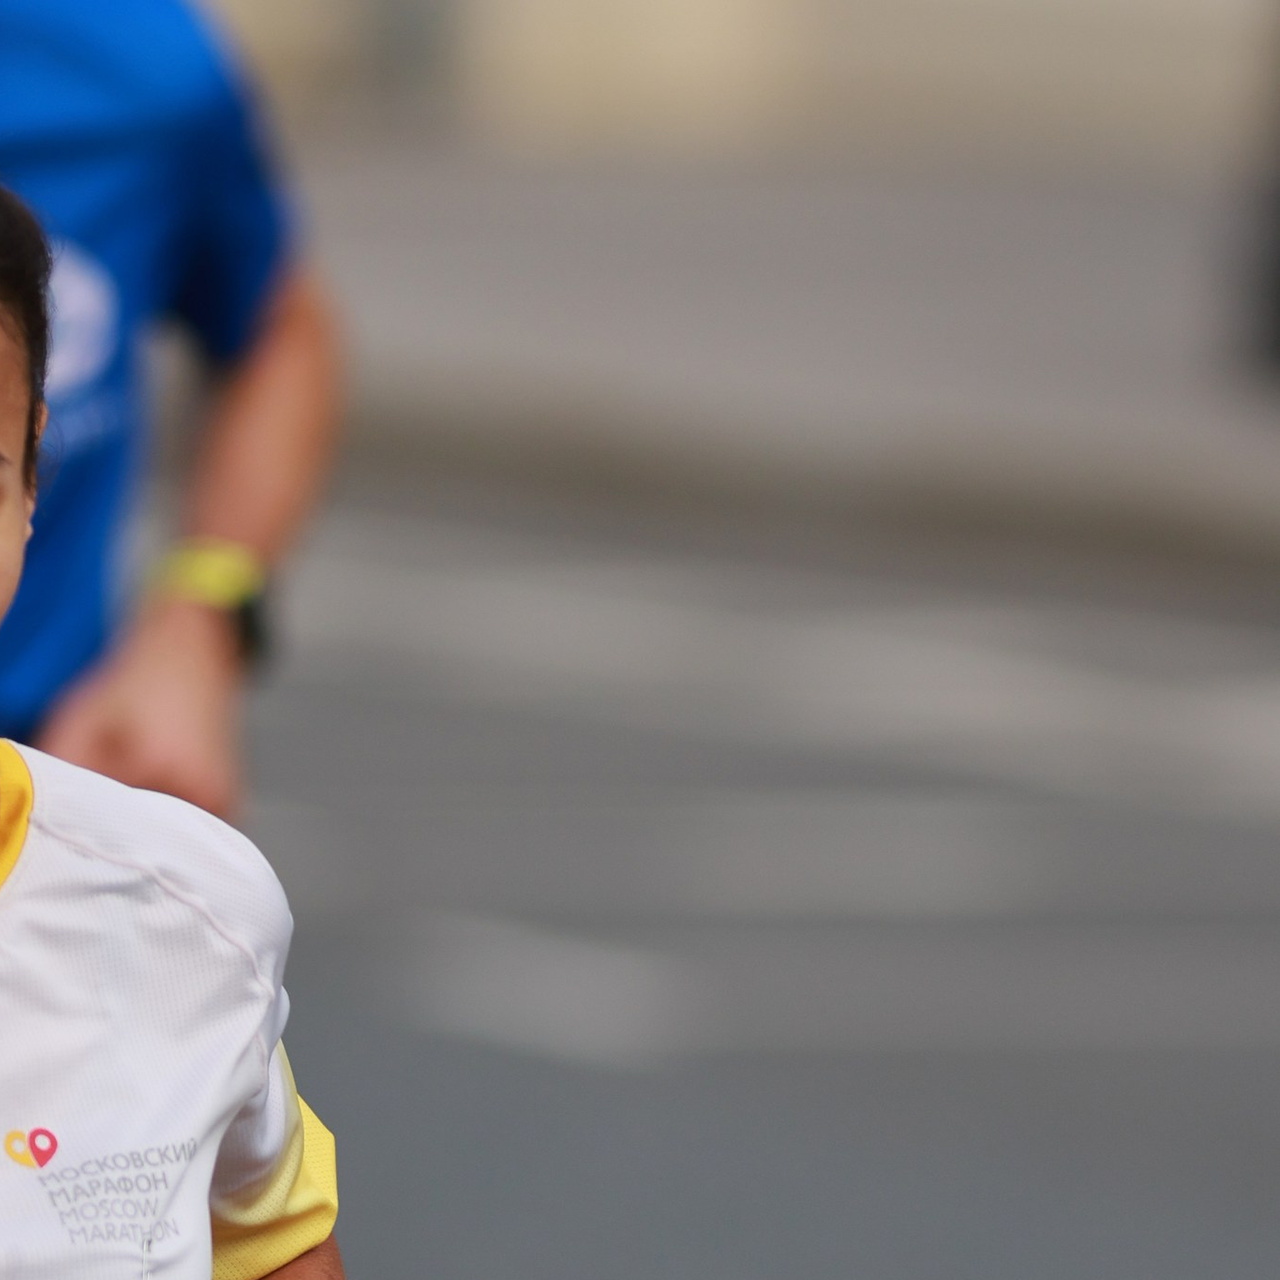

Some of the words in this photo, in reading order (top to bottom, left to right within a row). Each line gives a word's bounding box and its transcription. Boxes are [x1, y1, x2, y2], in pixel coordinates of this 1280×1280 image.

[38, 1138, 198, 1187] МОСКОВСКИЙ
[48, 1171, 169, 1207] МАРАФОН
[58, 1197, 158, 1225] MOSCOW
[67, 1218, 181, 1245] MARATHON
